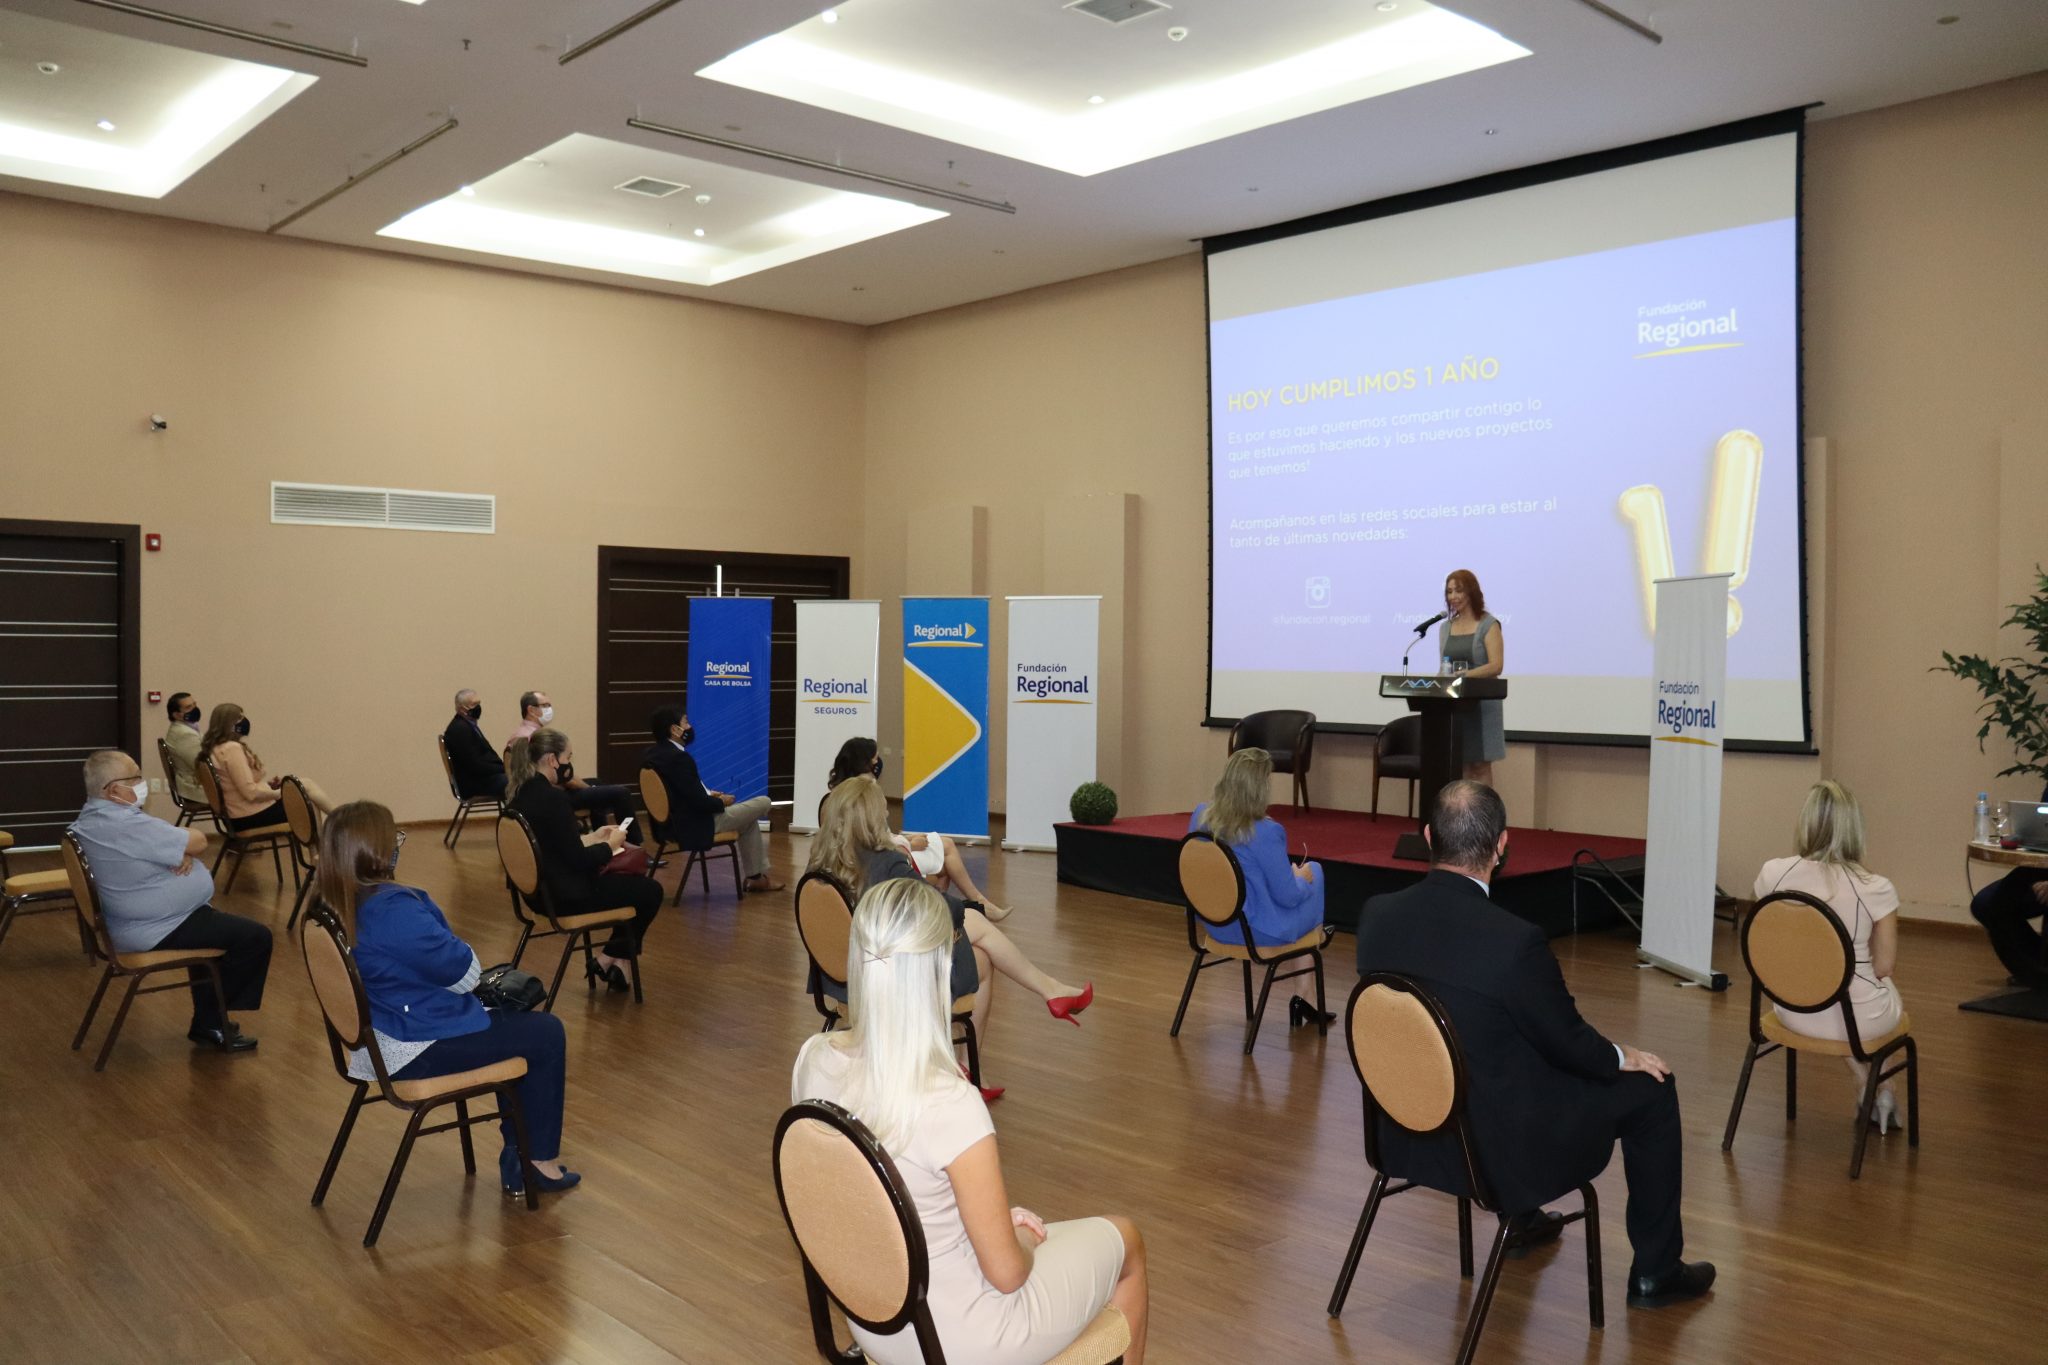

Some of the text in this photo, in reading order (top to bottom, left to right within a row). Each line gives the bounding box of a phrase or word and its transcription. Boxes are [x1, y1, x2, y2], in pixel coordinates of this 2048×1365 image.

[1637, 297, 1706, 317] Fundación
[1638, 307, 1738, 347] Regional
[1228, 355, 1500, 412] HOY CUMPLIMOS 1 AÑO
[1228, 397, 1543, 445] Es por eso que queremos compartir contigo lo
[1228, 417, 1553, 462] que estuvimos haciendo y los nuevos proyectos
[1228, 468, 1250, 480] que
[1230, 496, 1557, 531] Acompañanos en las redes sociales para estar al
[1230, 535, 1261, 549] tanto
[1264, 533, 1280, 546] de
[914, 624, 963, 640] Regional
[706, 661, 750, 675] Regional
[1017, 663, 1067, 673] Fundación
[804, 678, 868, 698] Regional
[1017, 675, 1089, 698] Regional
[1659, 680, 1700, 695] Fundación
[814, 706, 858, 715] SEGUROS
[1658, 699, 1716, 734] Regional
